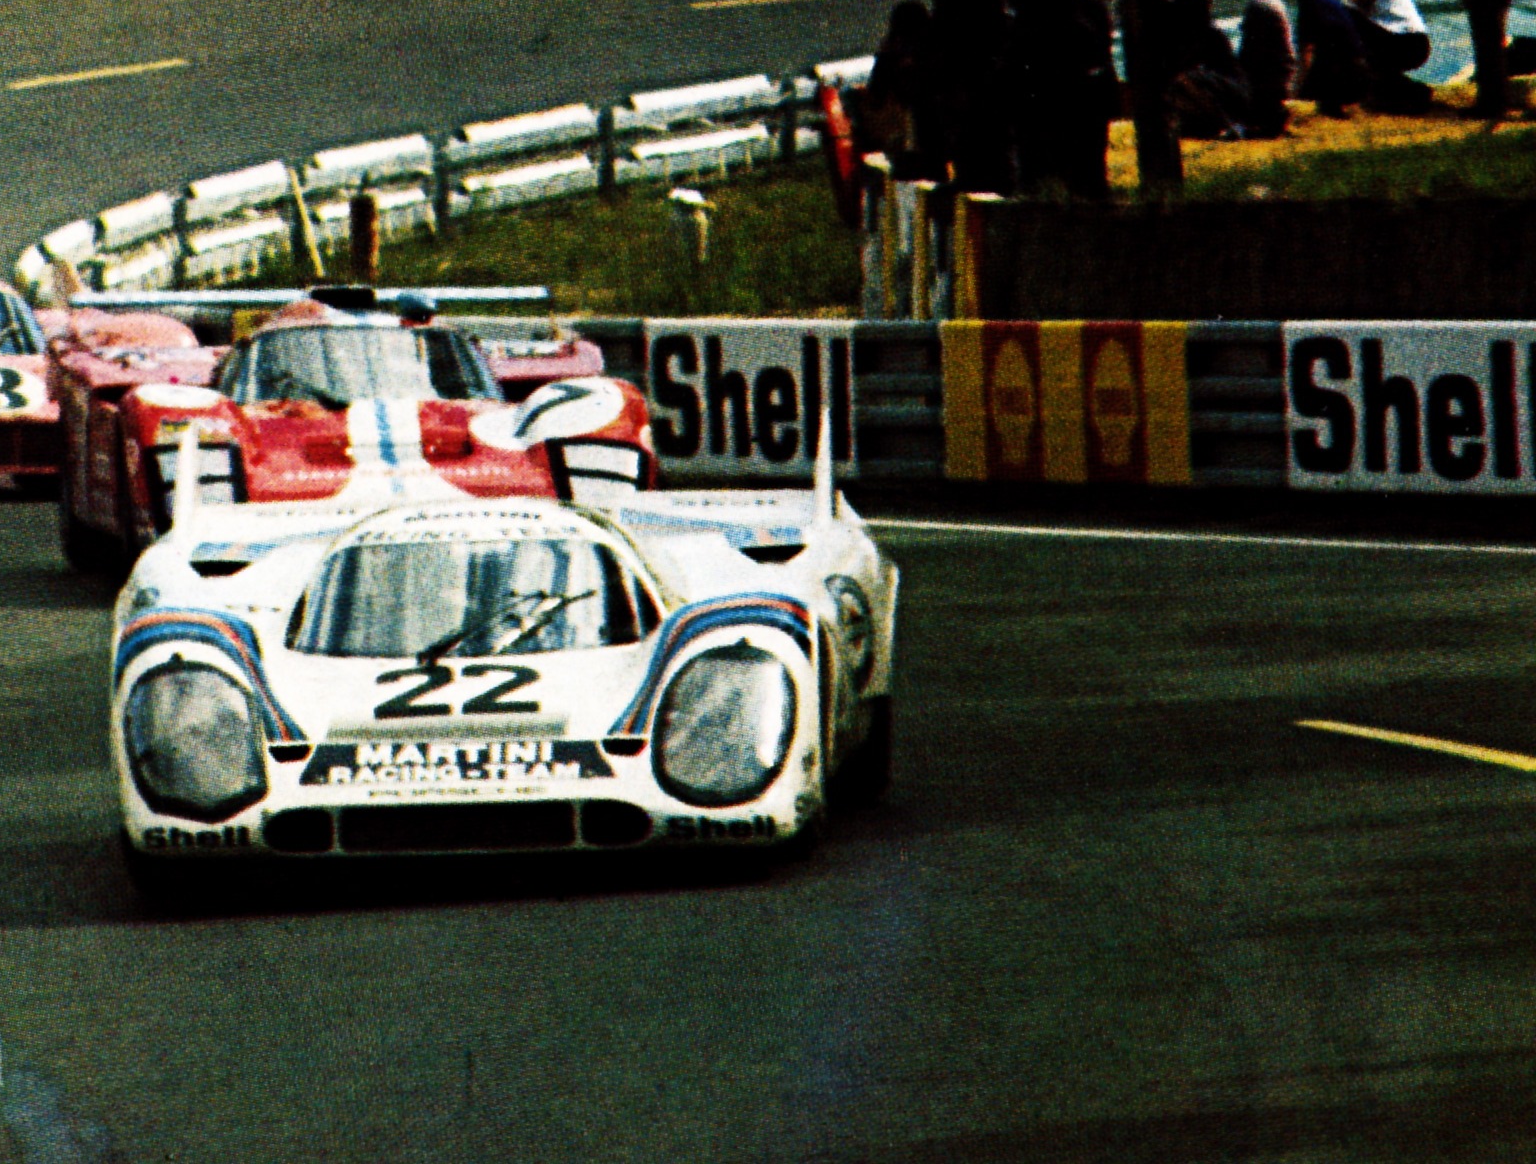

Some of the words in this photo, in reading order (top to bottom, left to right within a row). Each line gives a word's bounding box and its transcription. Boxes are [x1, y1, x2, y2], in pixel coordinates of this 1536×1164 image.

[514, 382, 594, 439] 7
[649, 334, 851, 461] Shell
[1291, 336, 1536, 480] Shel
[374, 664, 541, 719] 22
[356, 742, 555, 765] MARTINI
